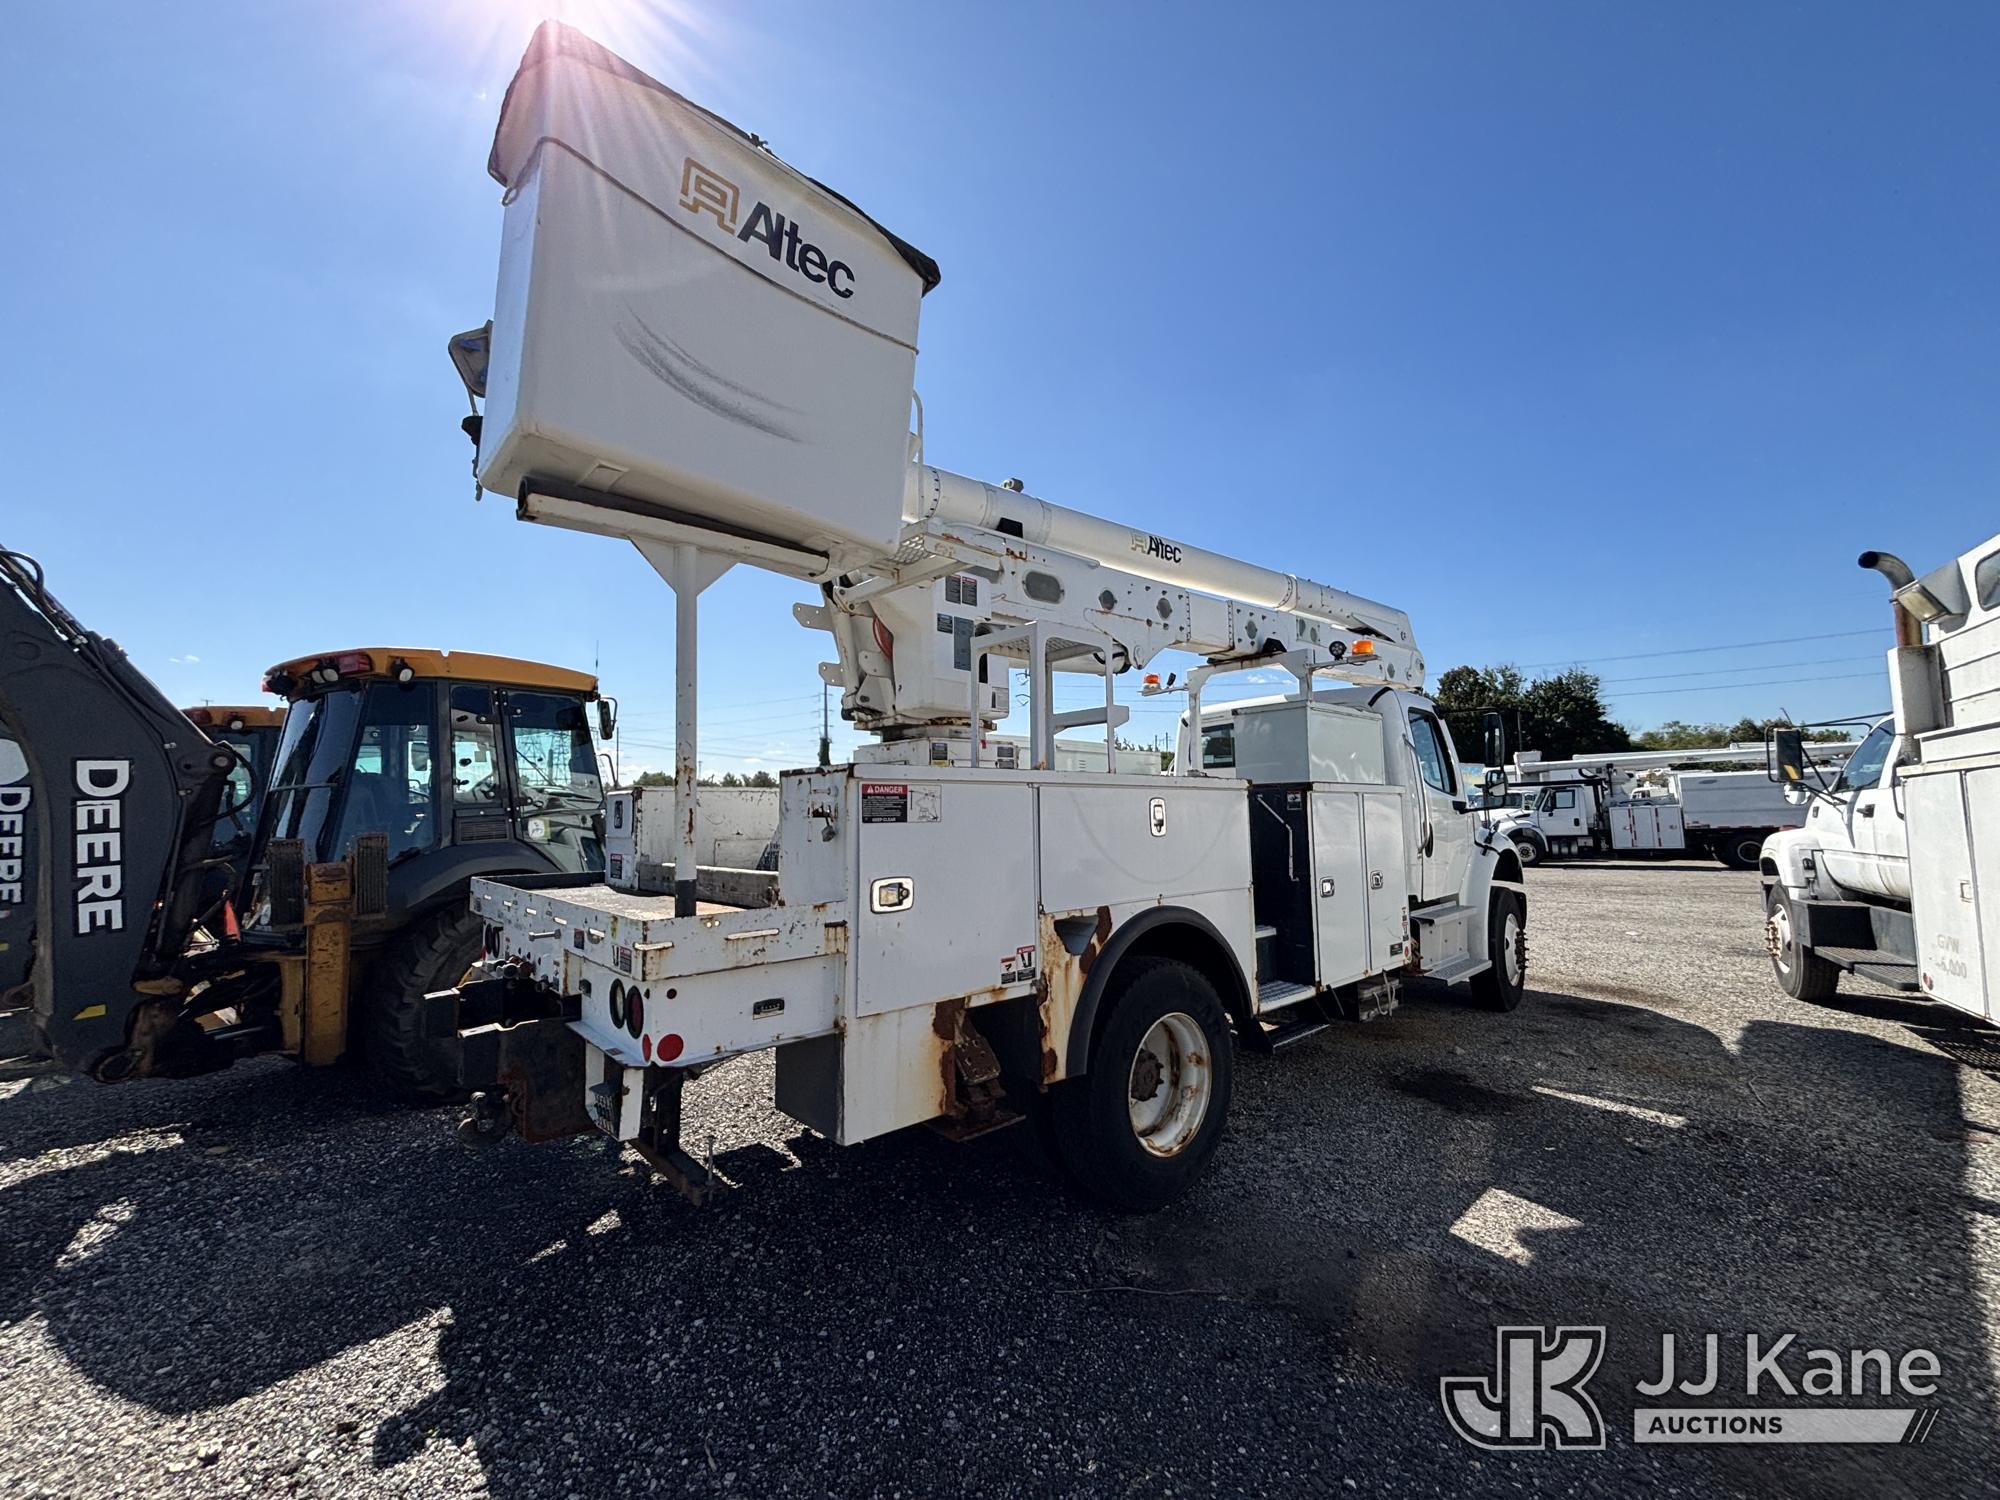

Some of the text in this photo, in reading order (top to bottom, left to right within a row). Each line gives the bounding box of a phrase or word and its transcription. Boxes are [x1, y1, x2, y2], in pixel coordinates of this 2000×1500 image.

[737, 201, 856, 299] Altec
[1147, 535, 1182, 563] Altec
[874, 785, 903, 794] DANGER
[76, 760, 130, 934] DEERE
